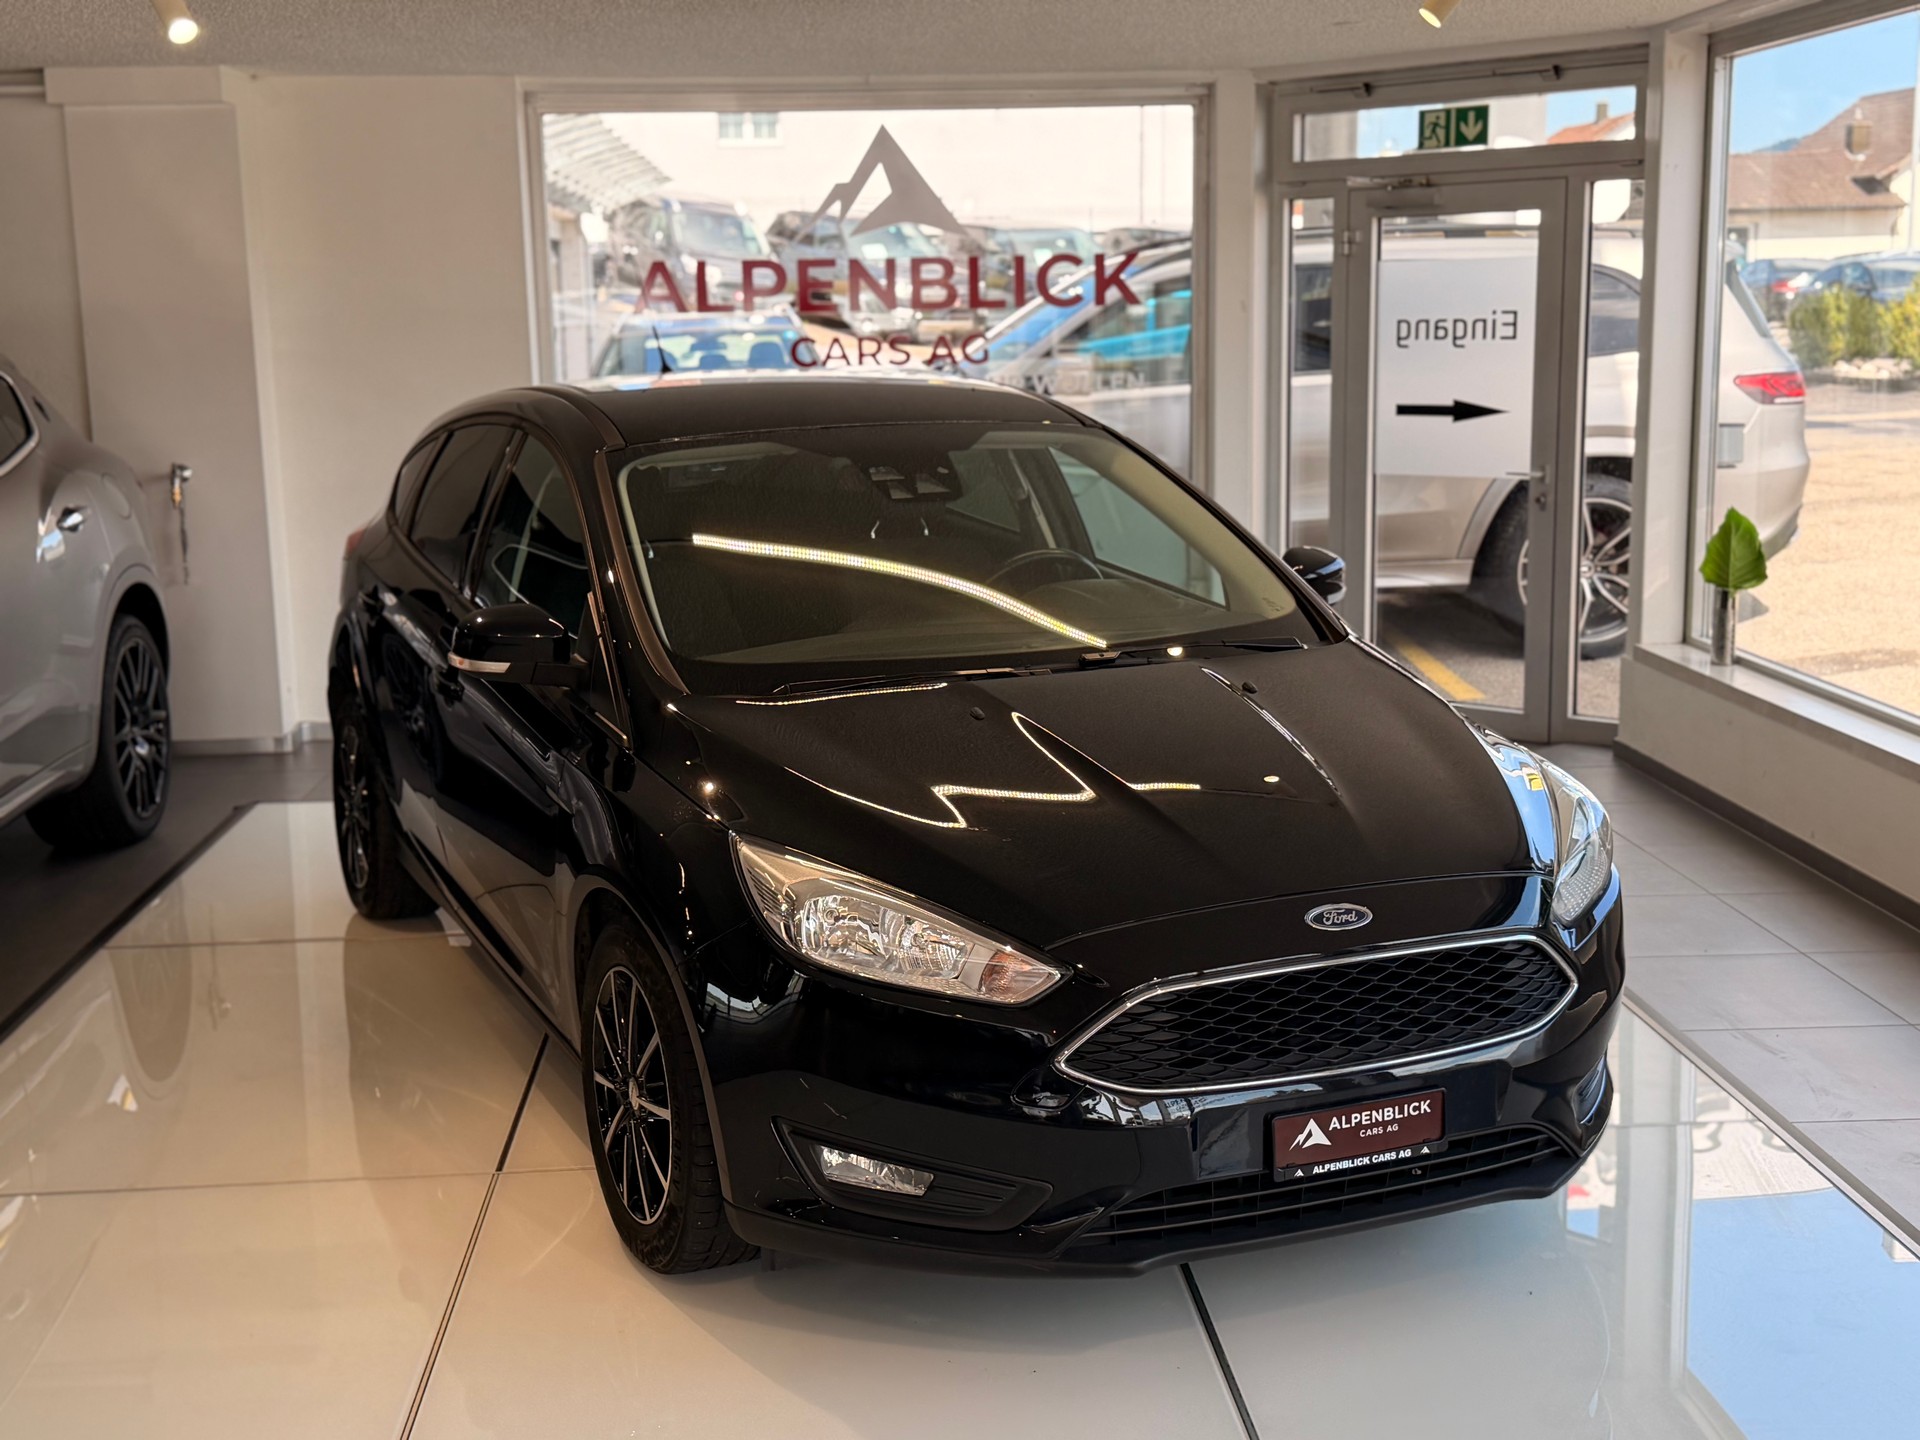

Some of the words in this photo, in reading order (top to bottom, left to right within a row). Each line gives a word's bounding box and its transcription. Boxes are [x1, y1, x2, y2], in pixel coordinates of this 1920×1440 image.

[634, 252, 1142, 313] ALPENBLICK
[790, 334, 911, 368] CARS
[927, 334, 990, 366] AG
[1323, 909, 1358, 925] Ford
[1328, 1099, 1431, 1131] ALPENBLICK
[1359, 1125, 1384, 1138] CARS
[1386, 1123, 1399, 1133] AG
[1312, 1155, 1370, 1174] ALPENBLICK
[1372, 1151, 1397, 1163] CARS
[1398, 1149, 1412, 1158] AG
